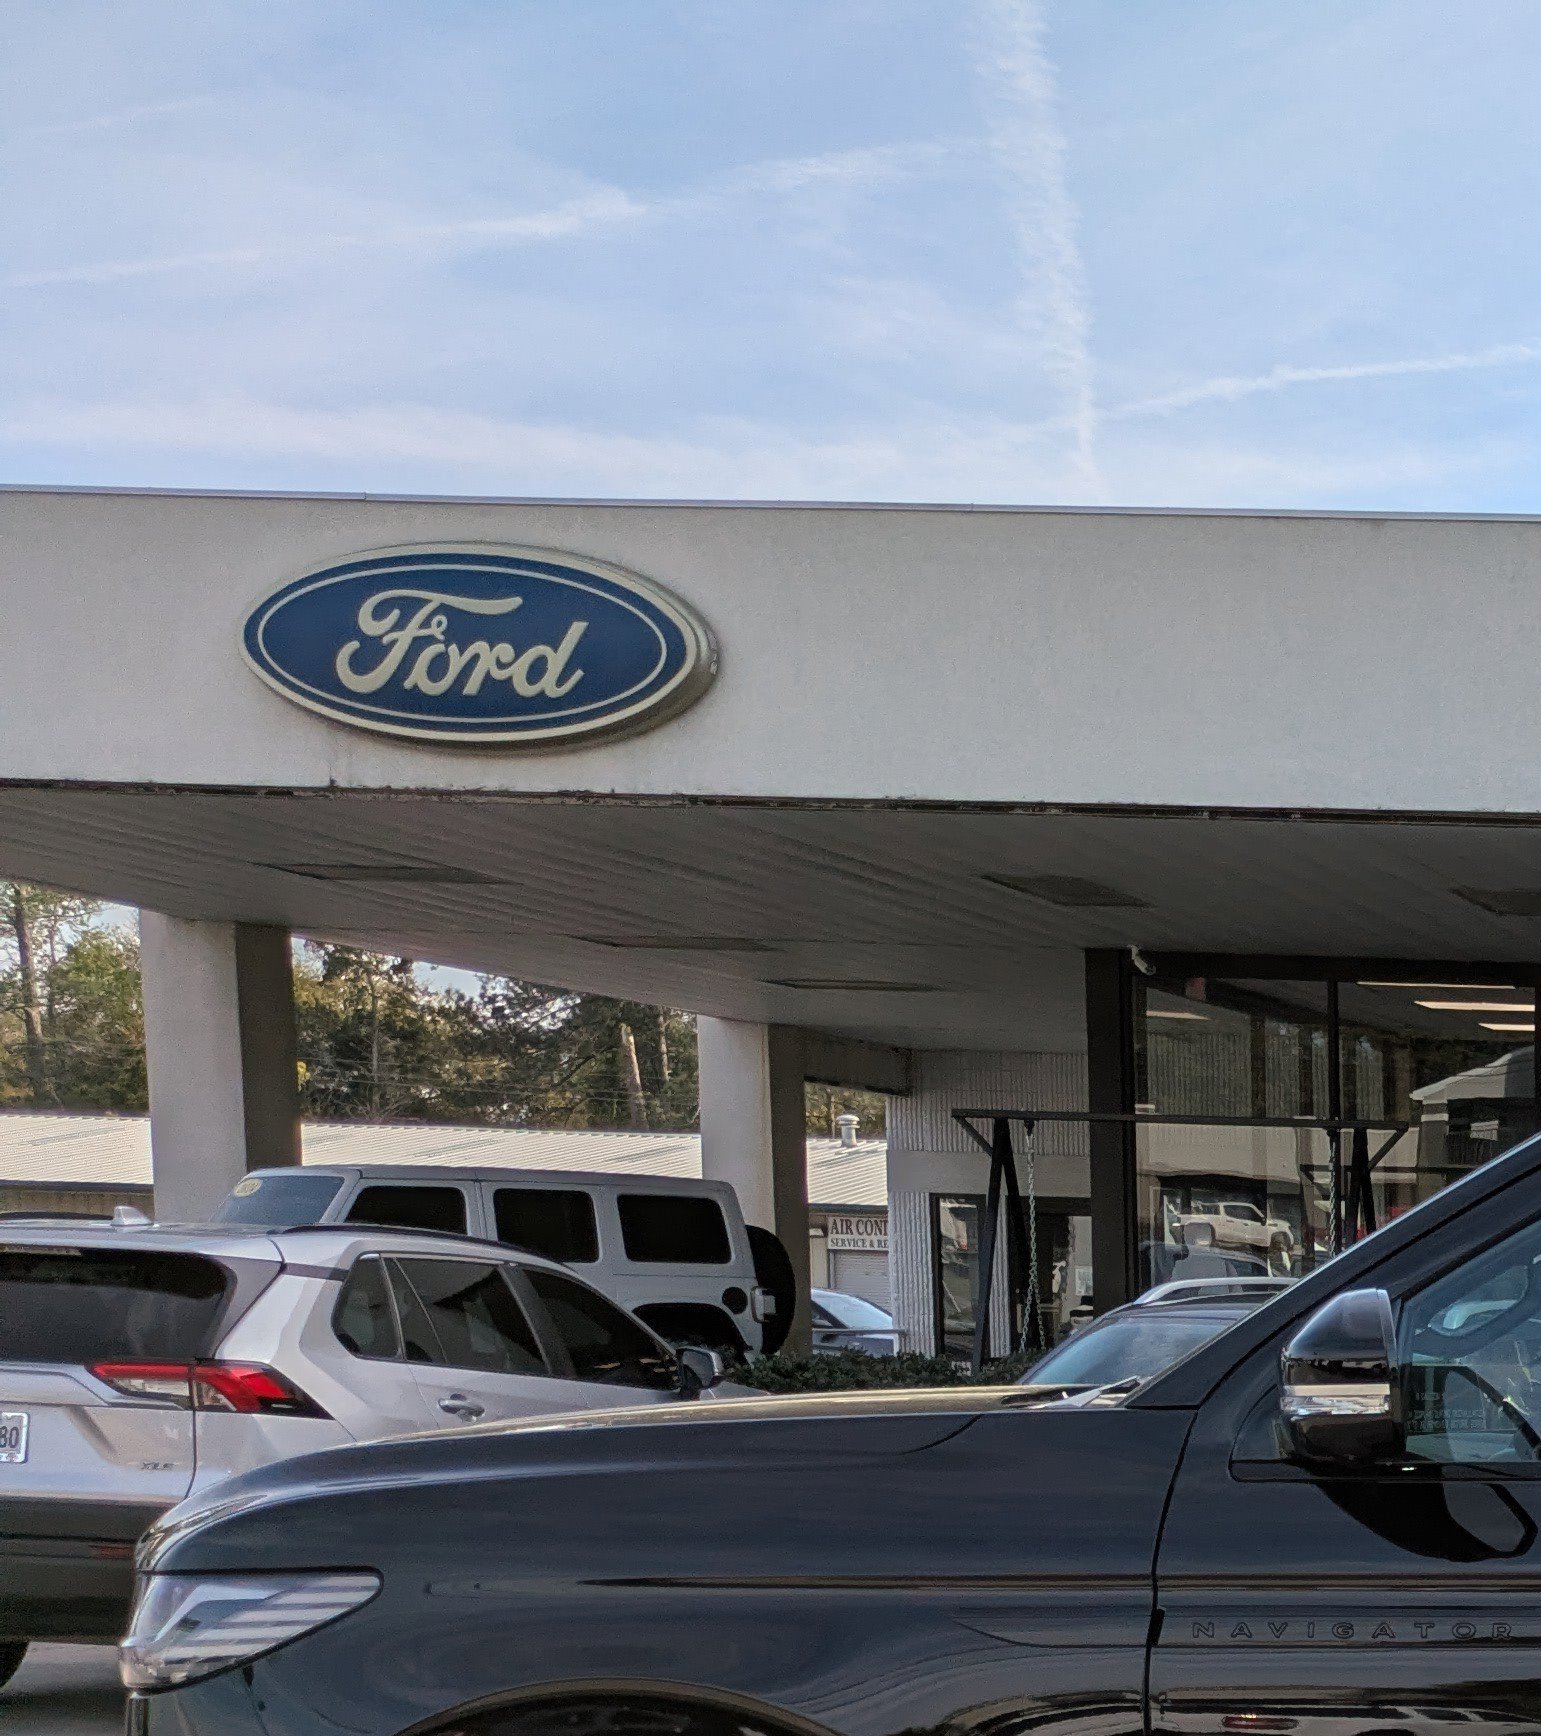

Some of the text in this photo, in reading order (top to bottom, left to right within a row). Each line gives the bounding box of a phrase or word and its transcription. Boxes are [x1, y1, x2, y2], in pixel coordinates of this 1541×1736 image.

[335, 589, 589, 698] Ford
[831, 1219, 853, 1235] AIR
[1192, 1620, 1515, 1641] NAVIGATOR
